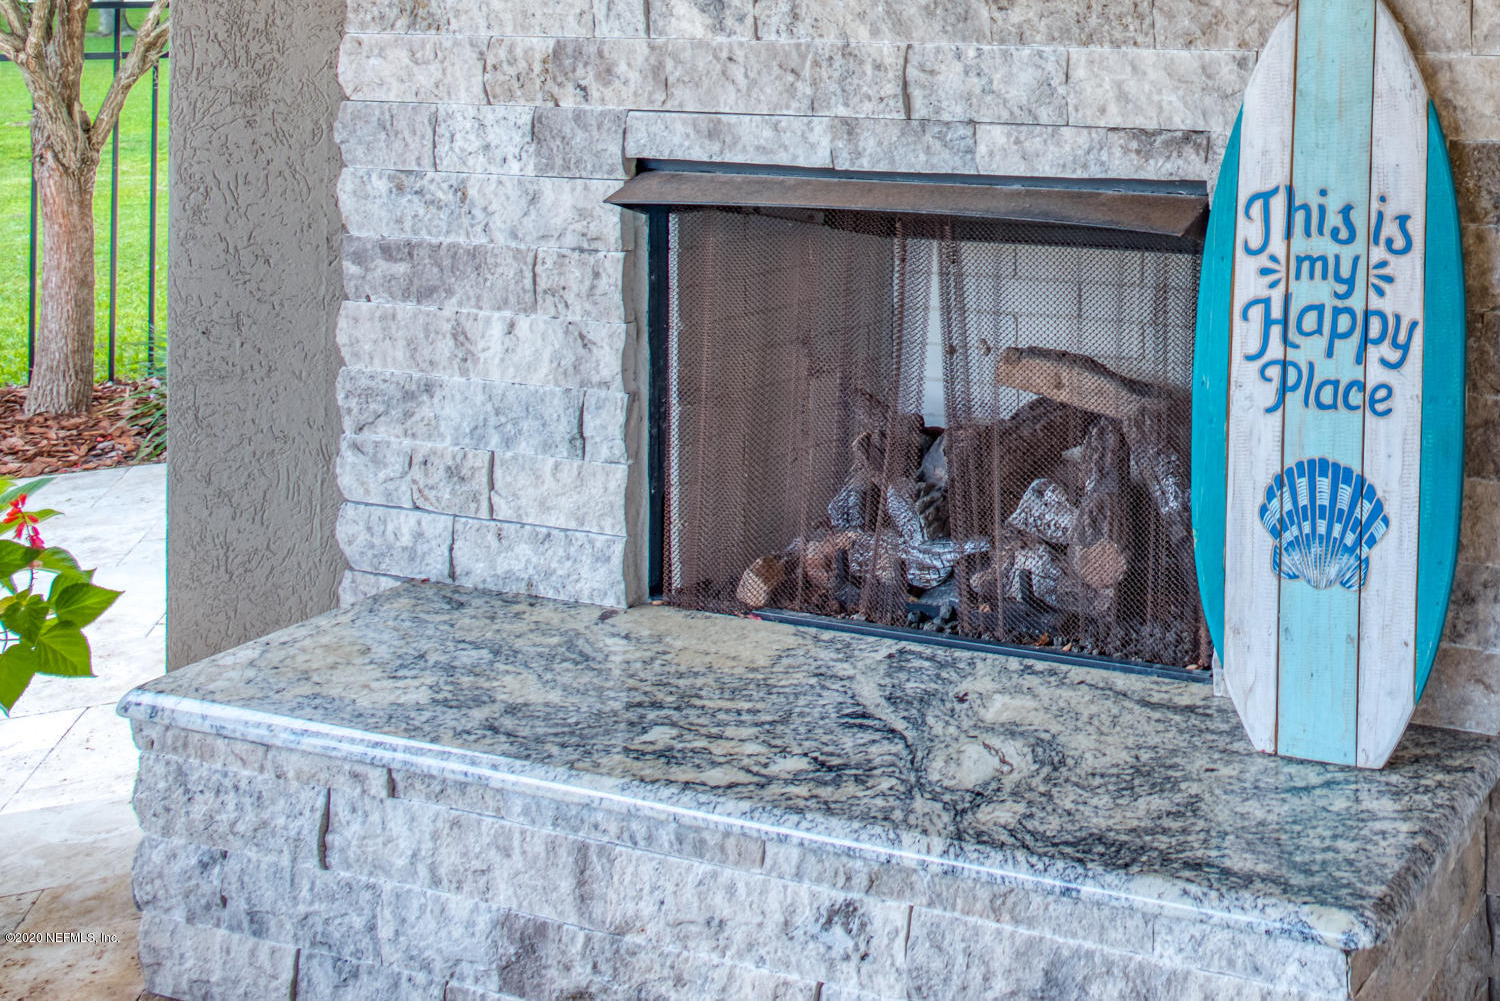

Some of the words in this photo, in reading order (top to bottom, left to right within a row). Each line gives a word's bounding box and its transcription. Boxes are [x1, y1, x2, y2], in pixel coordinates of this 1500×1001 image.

[1243, 184, 1357, 256] This
[1372, 195, 1413, 256] is
[1295, 254, 1361, 299] my
[1241, 292, 1419, 369] Happy
[1259, 359, 1393, 417] Place
